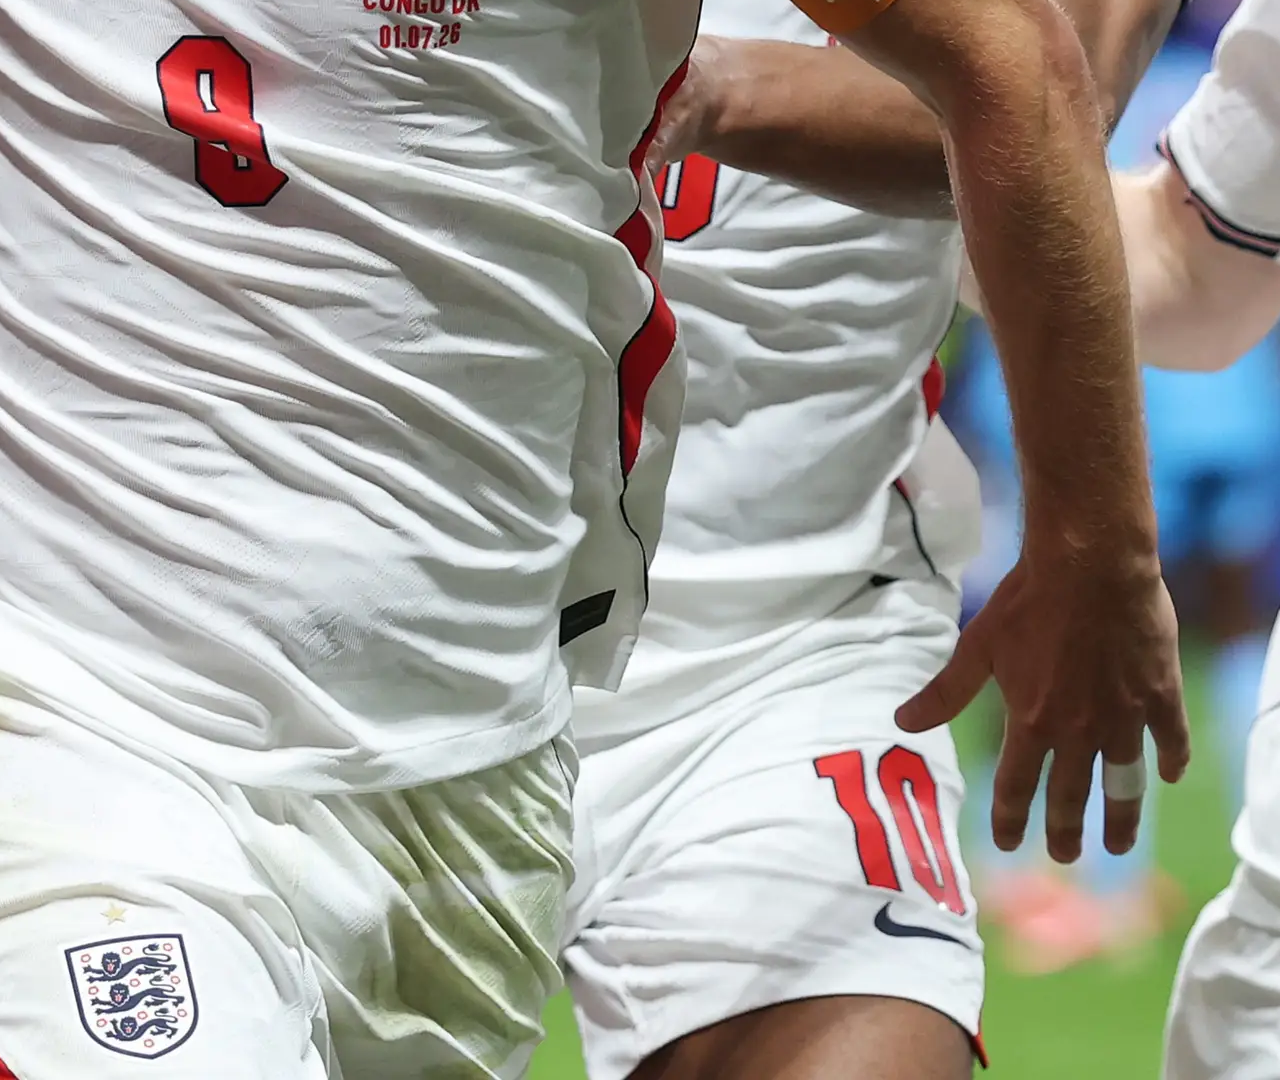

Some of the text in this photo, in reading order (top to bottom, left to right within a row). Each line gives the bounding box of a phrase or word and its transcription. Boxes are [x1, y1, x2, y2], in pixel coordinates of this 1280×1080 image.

[156, 35, 289, 207] 9
[379, 23, 461, 49] 01.07.26
[813, 744, 966, 916] 10
